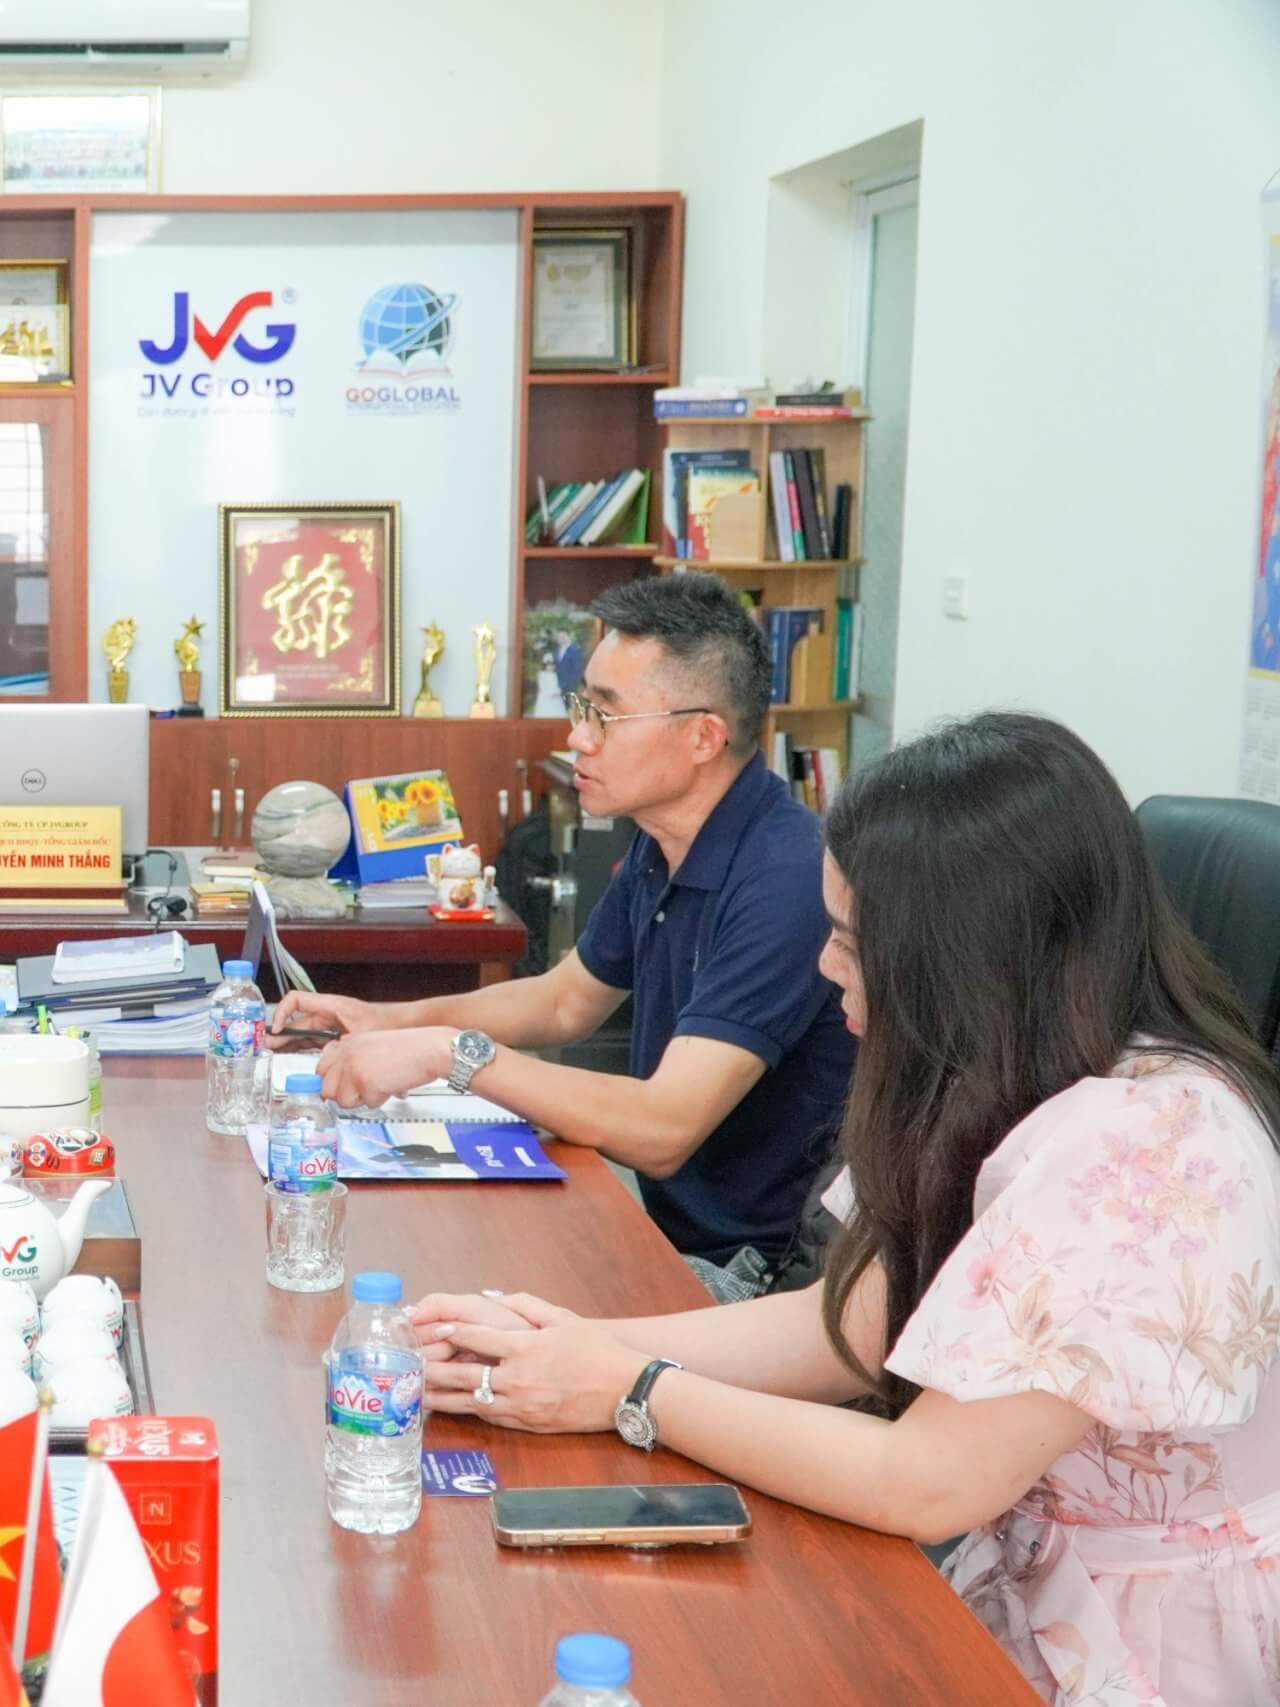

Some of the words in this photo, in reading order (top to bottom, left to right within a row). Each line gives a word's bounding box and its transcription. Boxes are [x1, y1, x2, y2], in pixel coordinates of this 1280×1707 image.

[138, 291, 297, 365] JVG
[140, 373, 182, 398] JV
[345, 387, 461, 402] GOGLOBAL
[31, 854, 64, 868] MINH
[3, 1265, 39, 1278] Group
[149, 1502, 165, 1517] N
